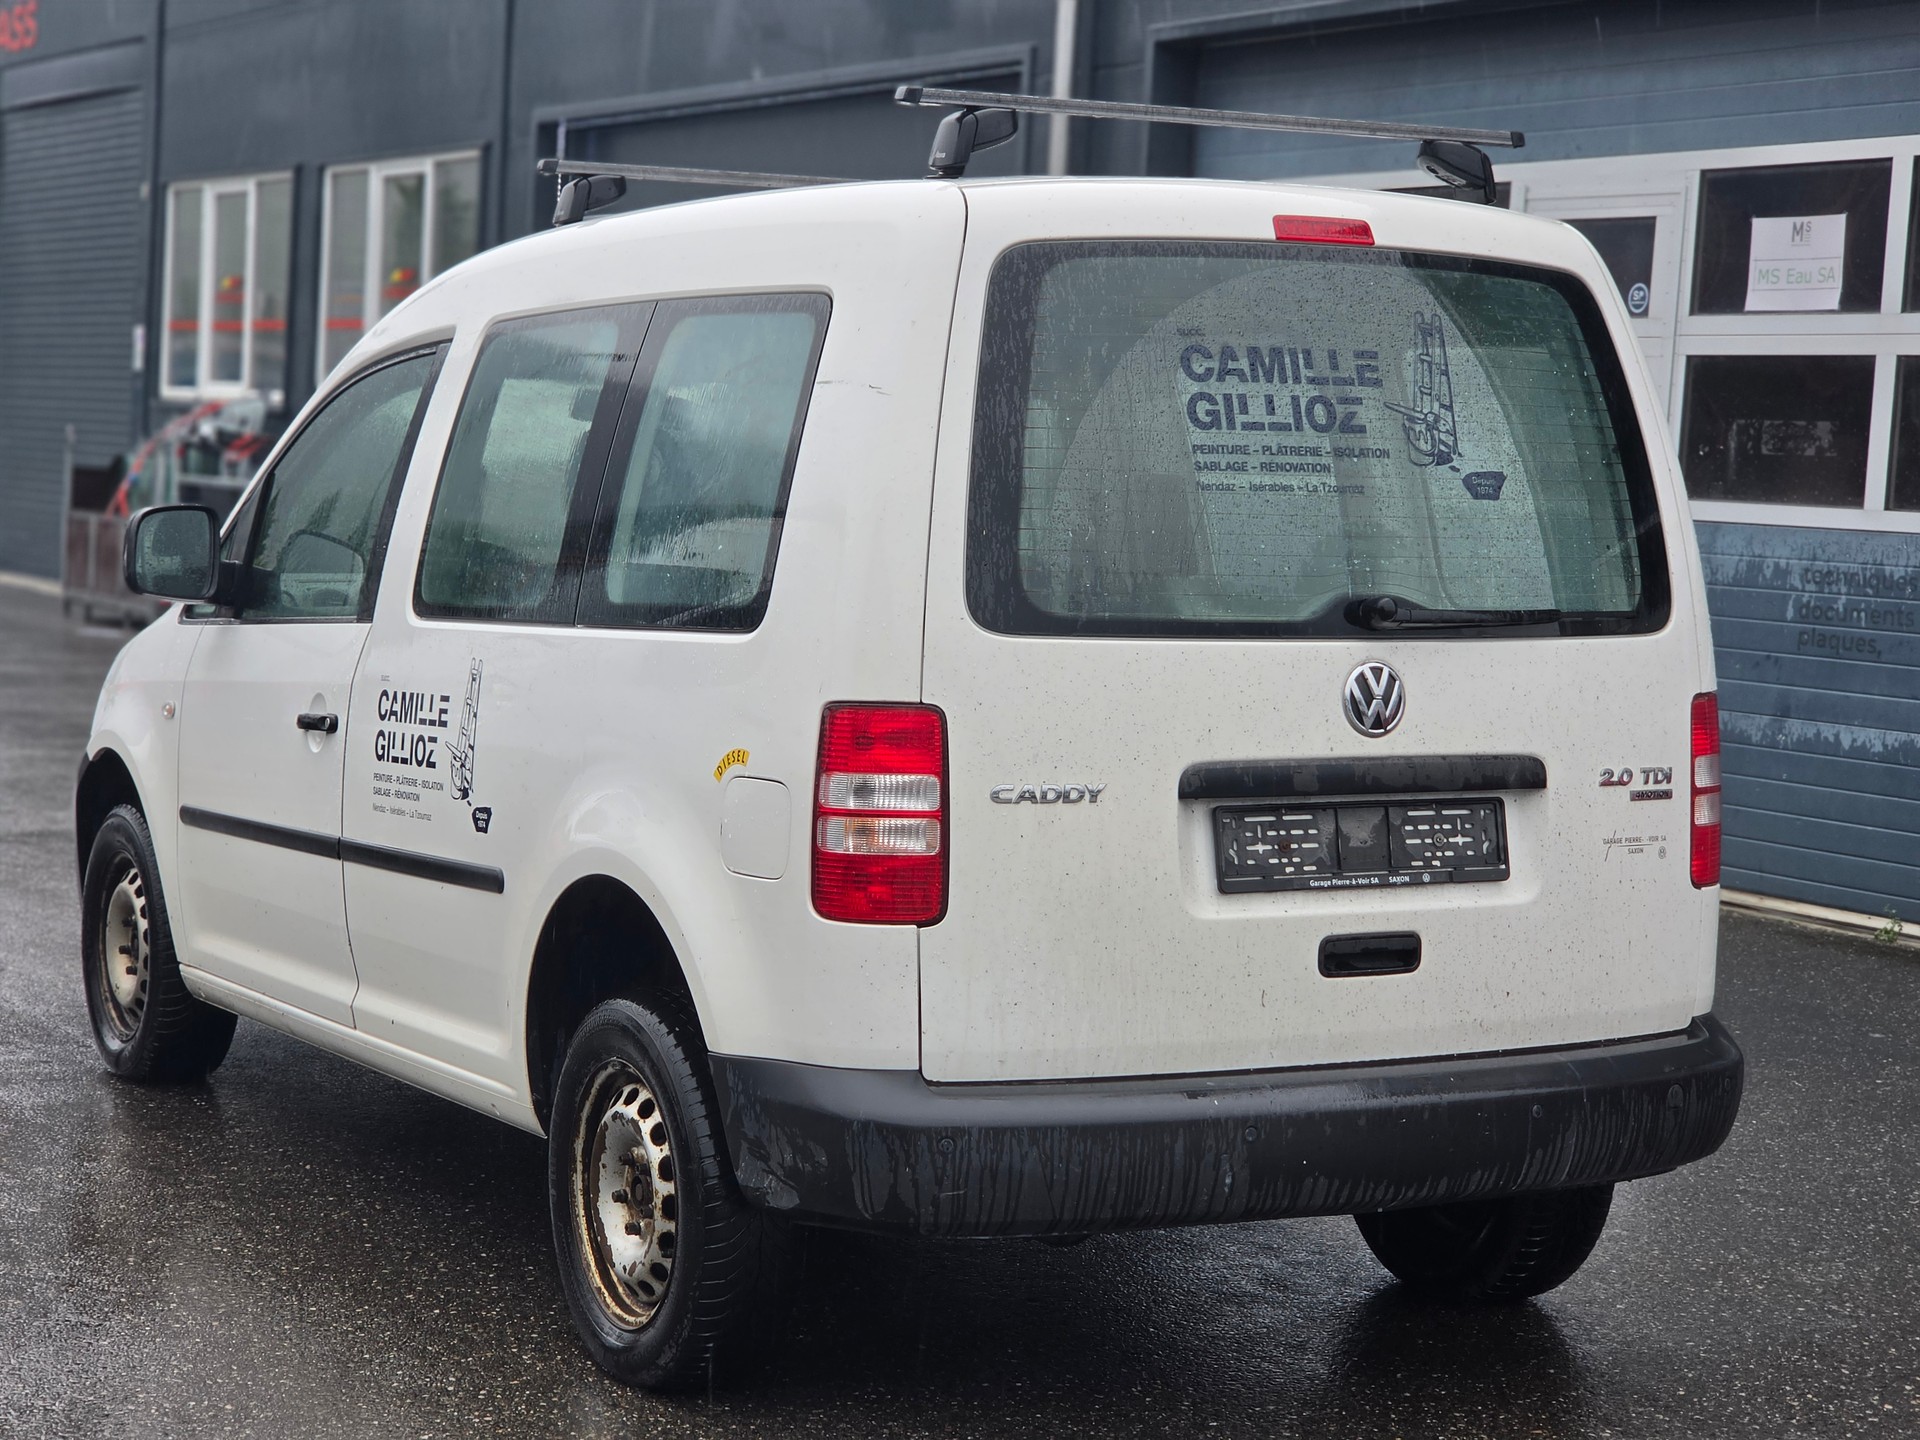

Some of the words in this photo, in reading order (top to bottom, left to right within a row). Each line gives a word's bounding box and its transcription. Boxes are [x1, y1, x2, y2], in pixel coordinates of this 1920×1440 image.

[1757, 269, 1780, 285] MS
[1786, 268, 1812, 285] Eau
[1818, 267, 1836, 284] SA
[1180, 344, 1383, 388] CAMILLE
[1186, 391, 1368, 434] GILLIOZ
[1192, 443, 1251, 457] PEINTURE
[1261, 442, 1323, 457] PLÂTRERIE
[1333, 445, 1390, 459] ISOLATION
[1193, 460, 1249, 473] SABLAGE
[1260, 459, 1332, 474] RÉNOVATION
[1196, 480, 1237, 493] Nendaz
[1248, 480, 1295, 493] Isérables
[1306, 481, 1319, 494] La
[1477, 486, 1493, 494] 1974
[1804, 566, 1918, 594] techniques
[1798, 600, 1915, 627] documents
[1796, 628, 1882, 659] plaques,
[377, 688, 450, 728] CAMILLE
[374, 729, 438, 769] GILLIOZ
[716, 749, 746, 777] DIESEL
[1598, 767, 1634, 787] 2.0
[1639, 766, 1673, 786] TDI
[989, 783, 1107, 805] CADDY
[1603, 837, 1623, 845] GARAGE
[1309, 879, 1332, 888] Garage
[1332, 878, 1370, 886] Pierre-à-Voir
[1388, 876, 1410, 884] SAXON
